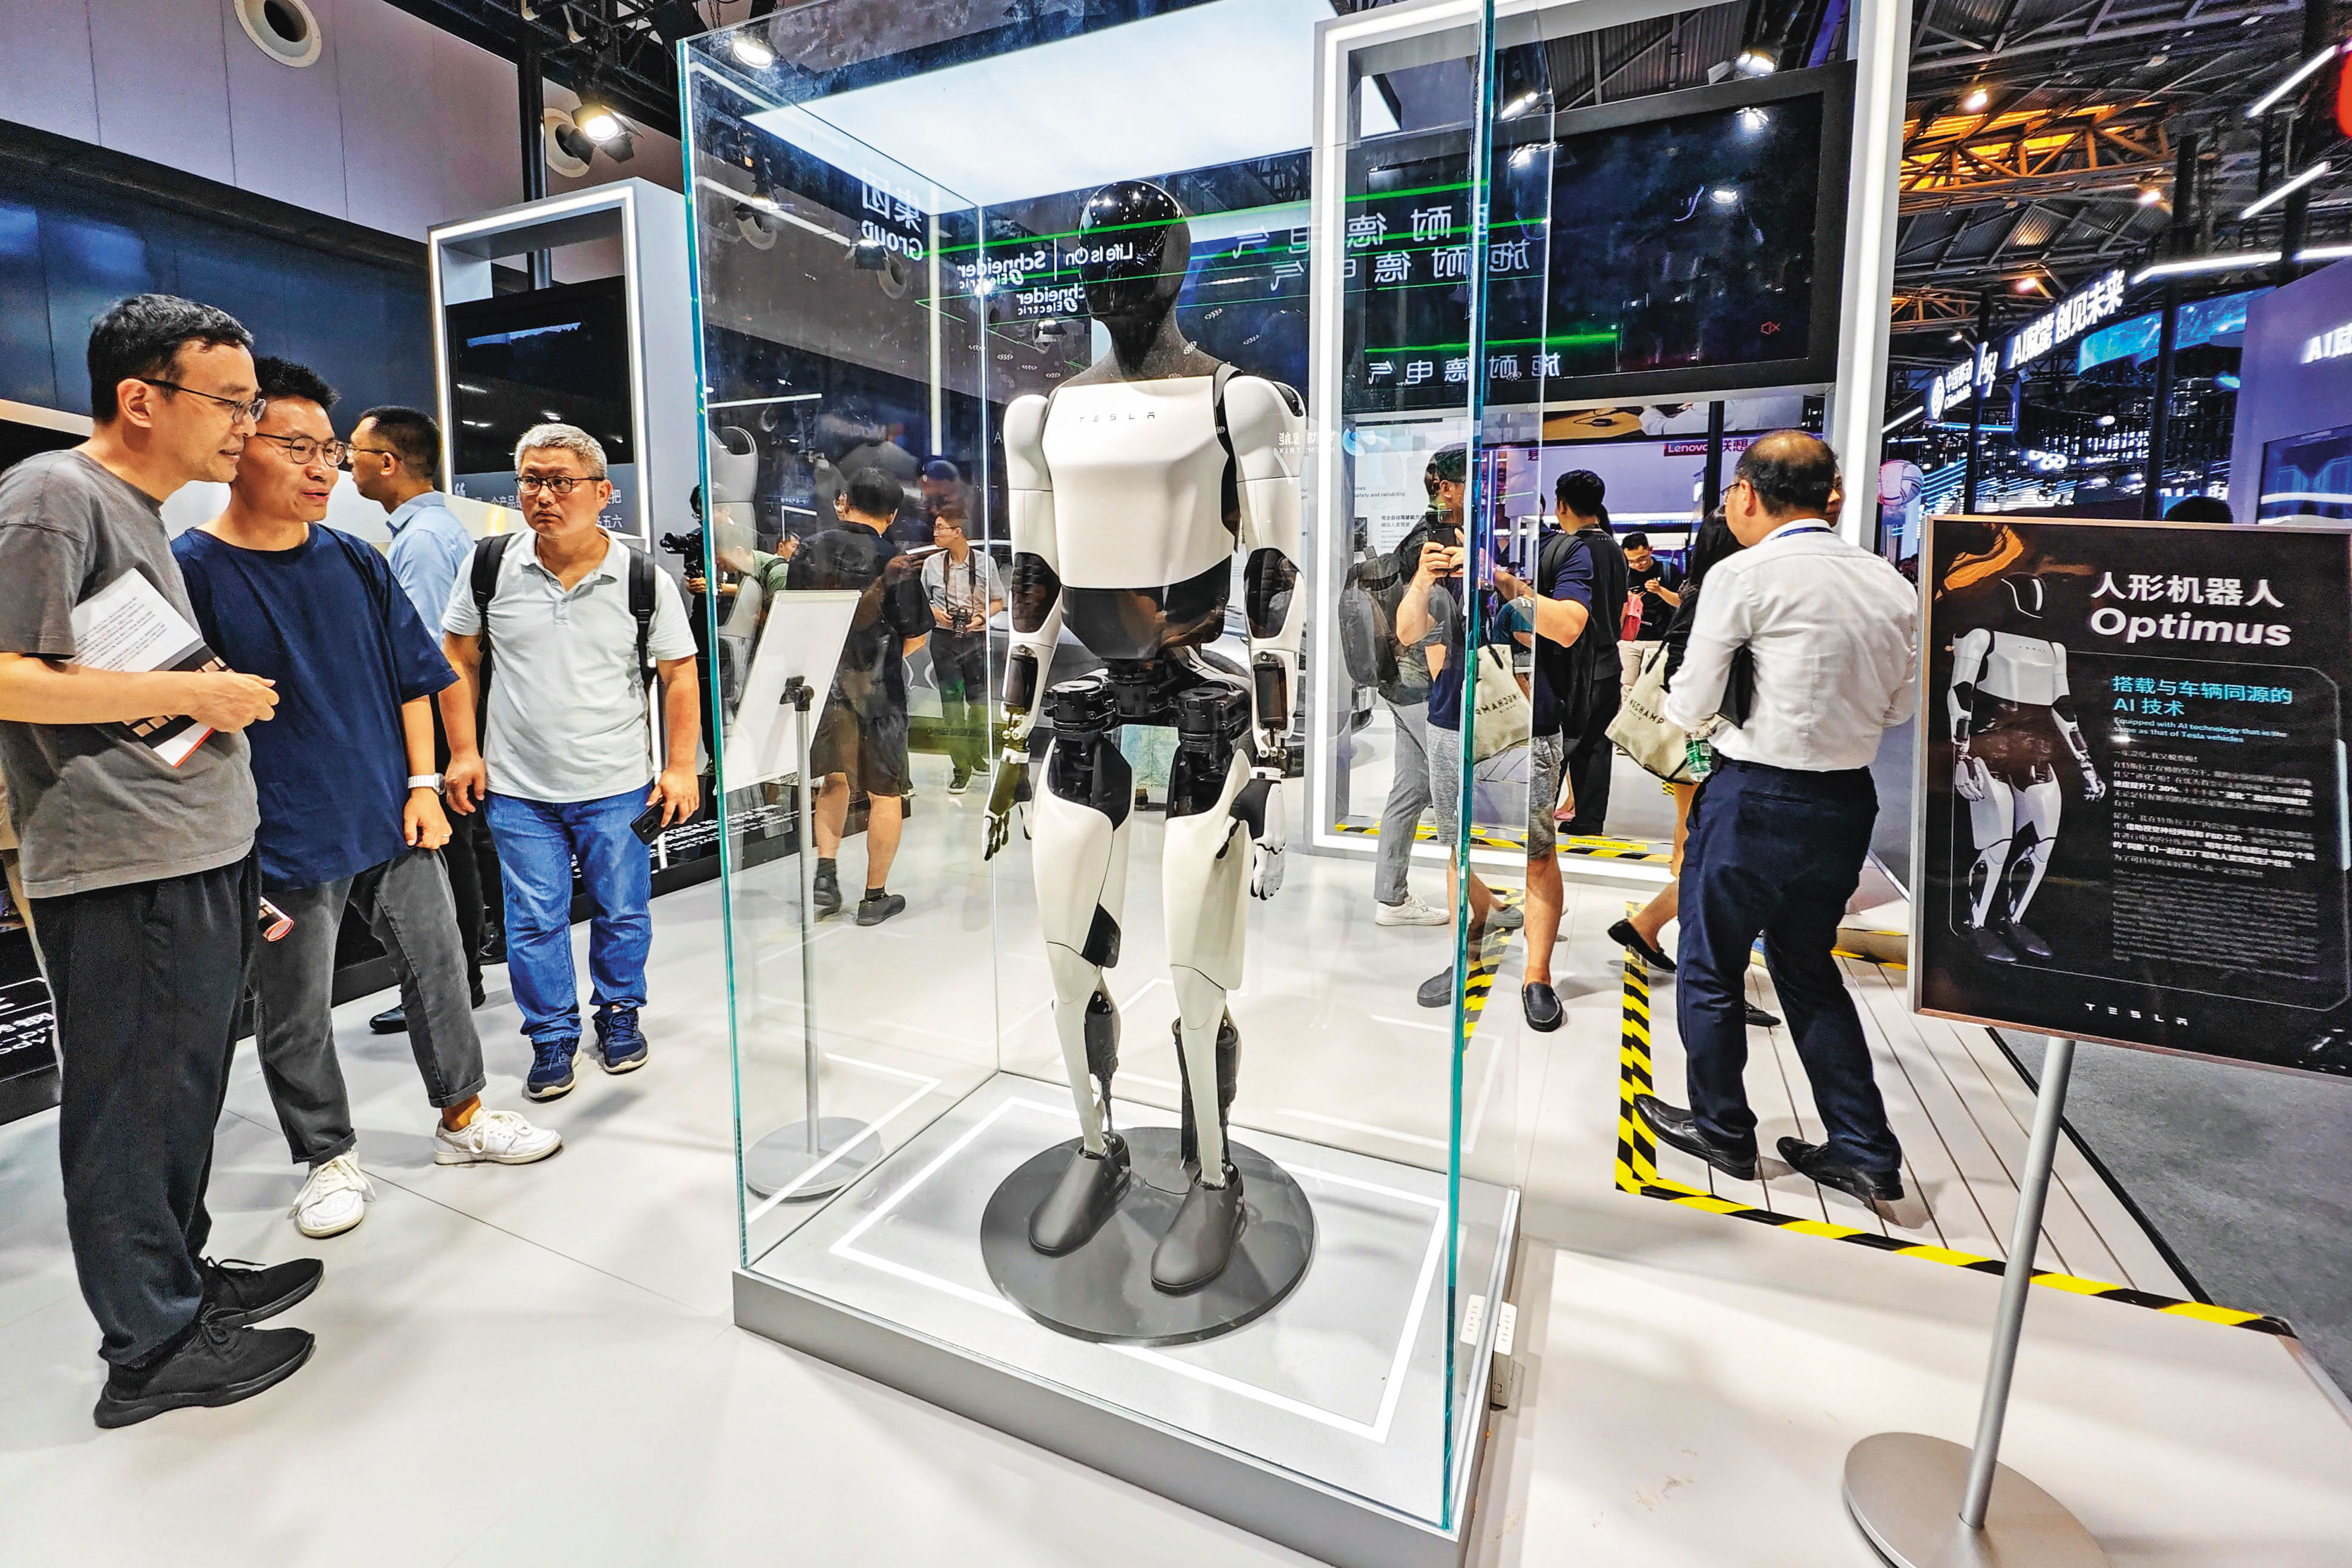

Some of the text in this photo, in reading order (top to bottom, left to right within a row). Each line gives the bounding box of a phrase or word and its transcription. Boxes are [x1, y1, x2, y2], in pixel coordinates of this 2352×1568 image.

[1079, 412, 1155, 423] TESLA
[2091, 571, 2285, 608] 人形机器人
[2091, 607, 2292, 646] Optimus
[2112, 675, 2293, 705] 搭载与车辆同源的
[2113, 697, 2185, 717] AI 技术
[2114, 717, 2155, 727] Equipped
[2156, 720, 2176, 729] with
[2190, 724, 2240, 735] technology
[2150, 728, 2169, 736] that
[2169, 729, 2180, 737] of
[2181, 731, 2206, 740] Tesla
[2206, 733, 2245, 743] vehicles
[2085, 1003, 2189, 1026] TESLA
[0, 1036, 47, 1055] ody
